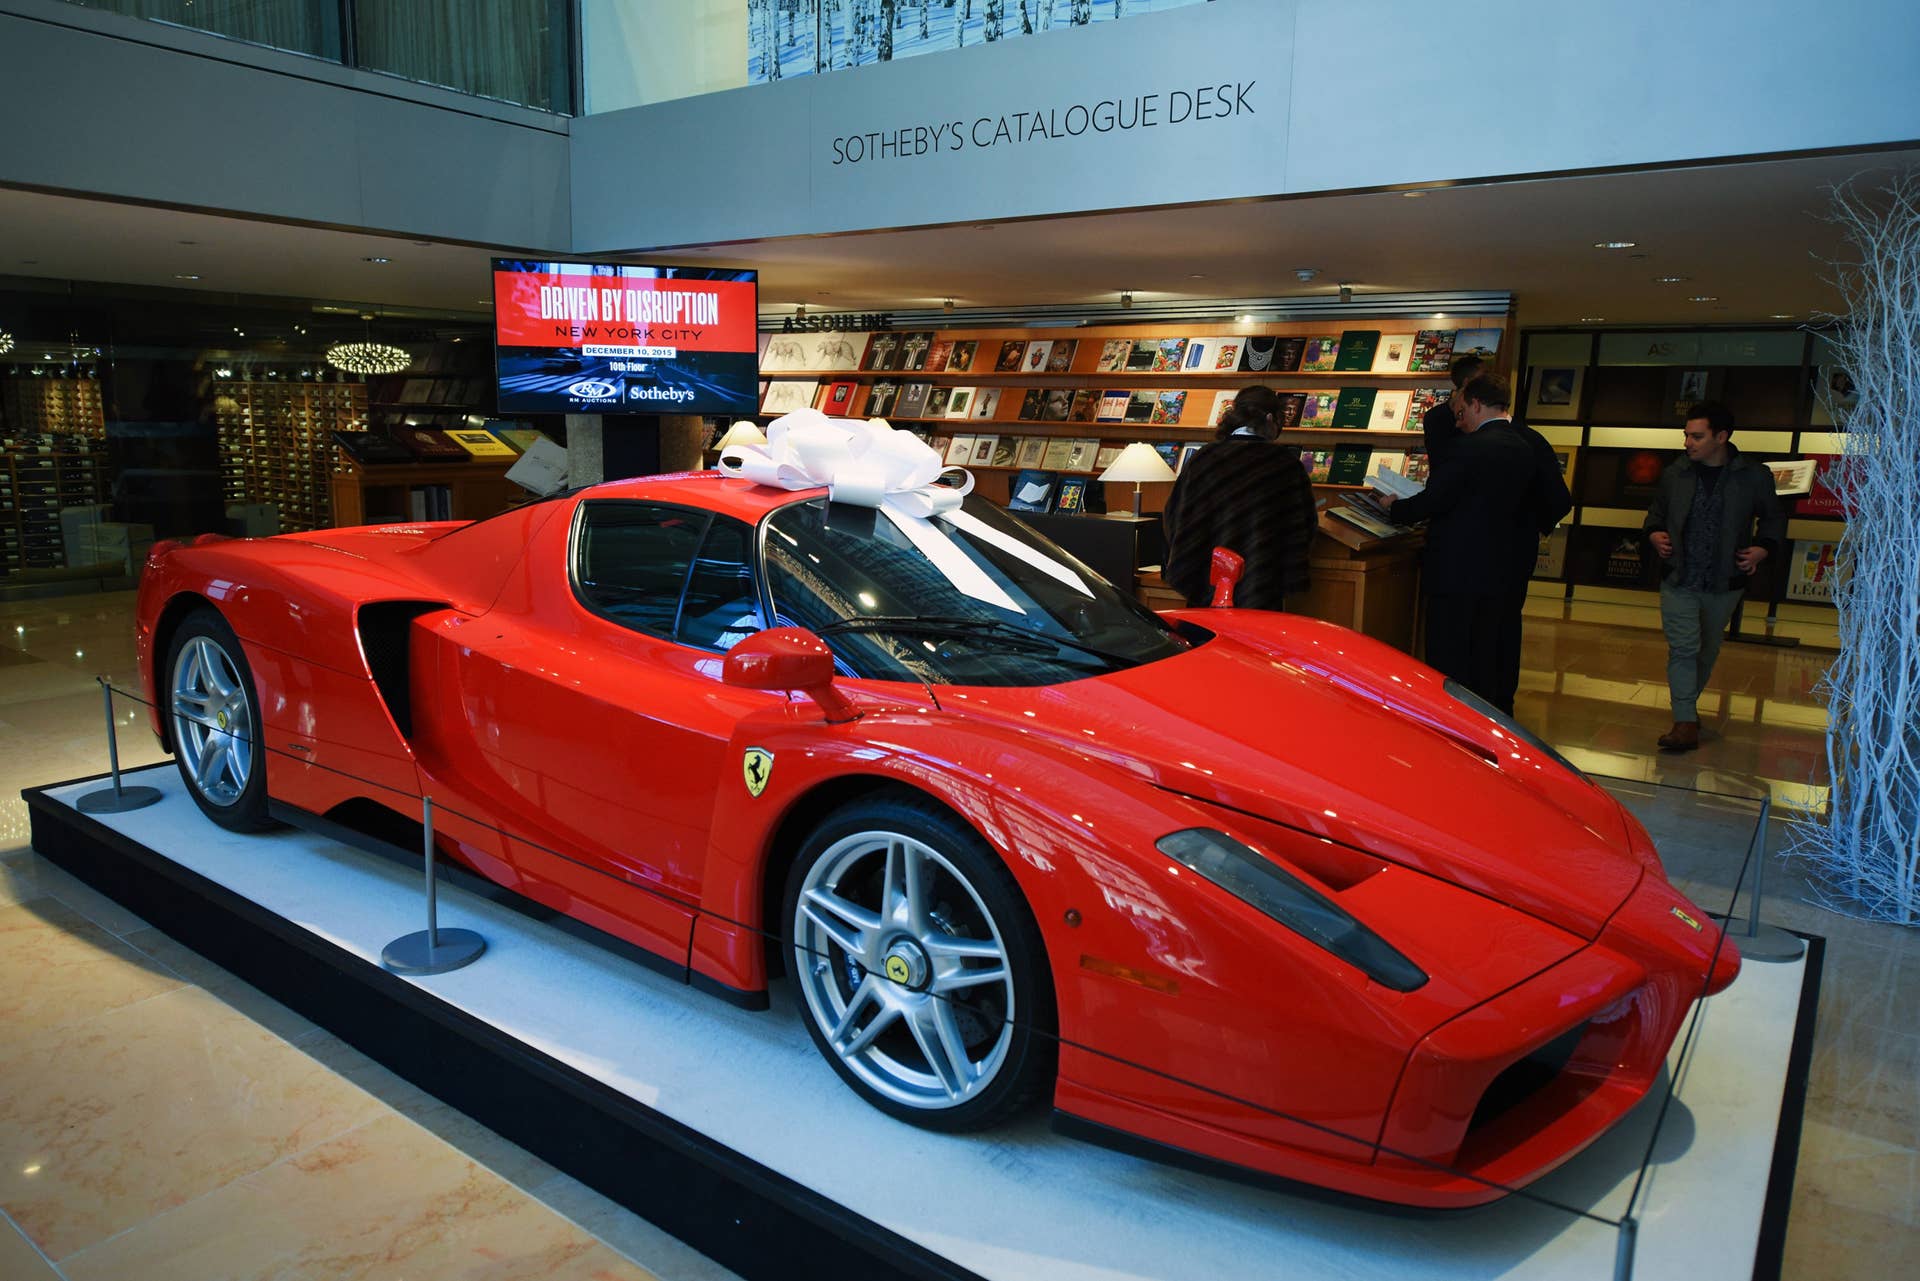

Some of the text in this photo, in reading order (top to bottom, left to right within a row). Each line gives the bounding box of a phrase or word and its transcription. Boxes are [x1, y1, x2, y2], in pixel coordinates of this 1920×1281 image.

[832, 80, 1256, 165] SOTHEBY'S CATALOGUE DESK
[540, 286, 718, 325] DRIVEN BY DISRUPTION
[782, 313, 893, 333] ASSOULINE
[555, 326, 703, 340] NEW YORK CITY
[586, 347, 634, 355] DECEMBER
[638, 348, 649, 356] 10,
[609, 361, 646, 371] 10th Floor
[630, 386, 695, 403] Sotheby's
